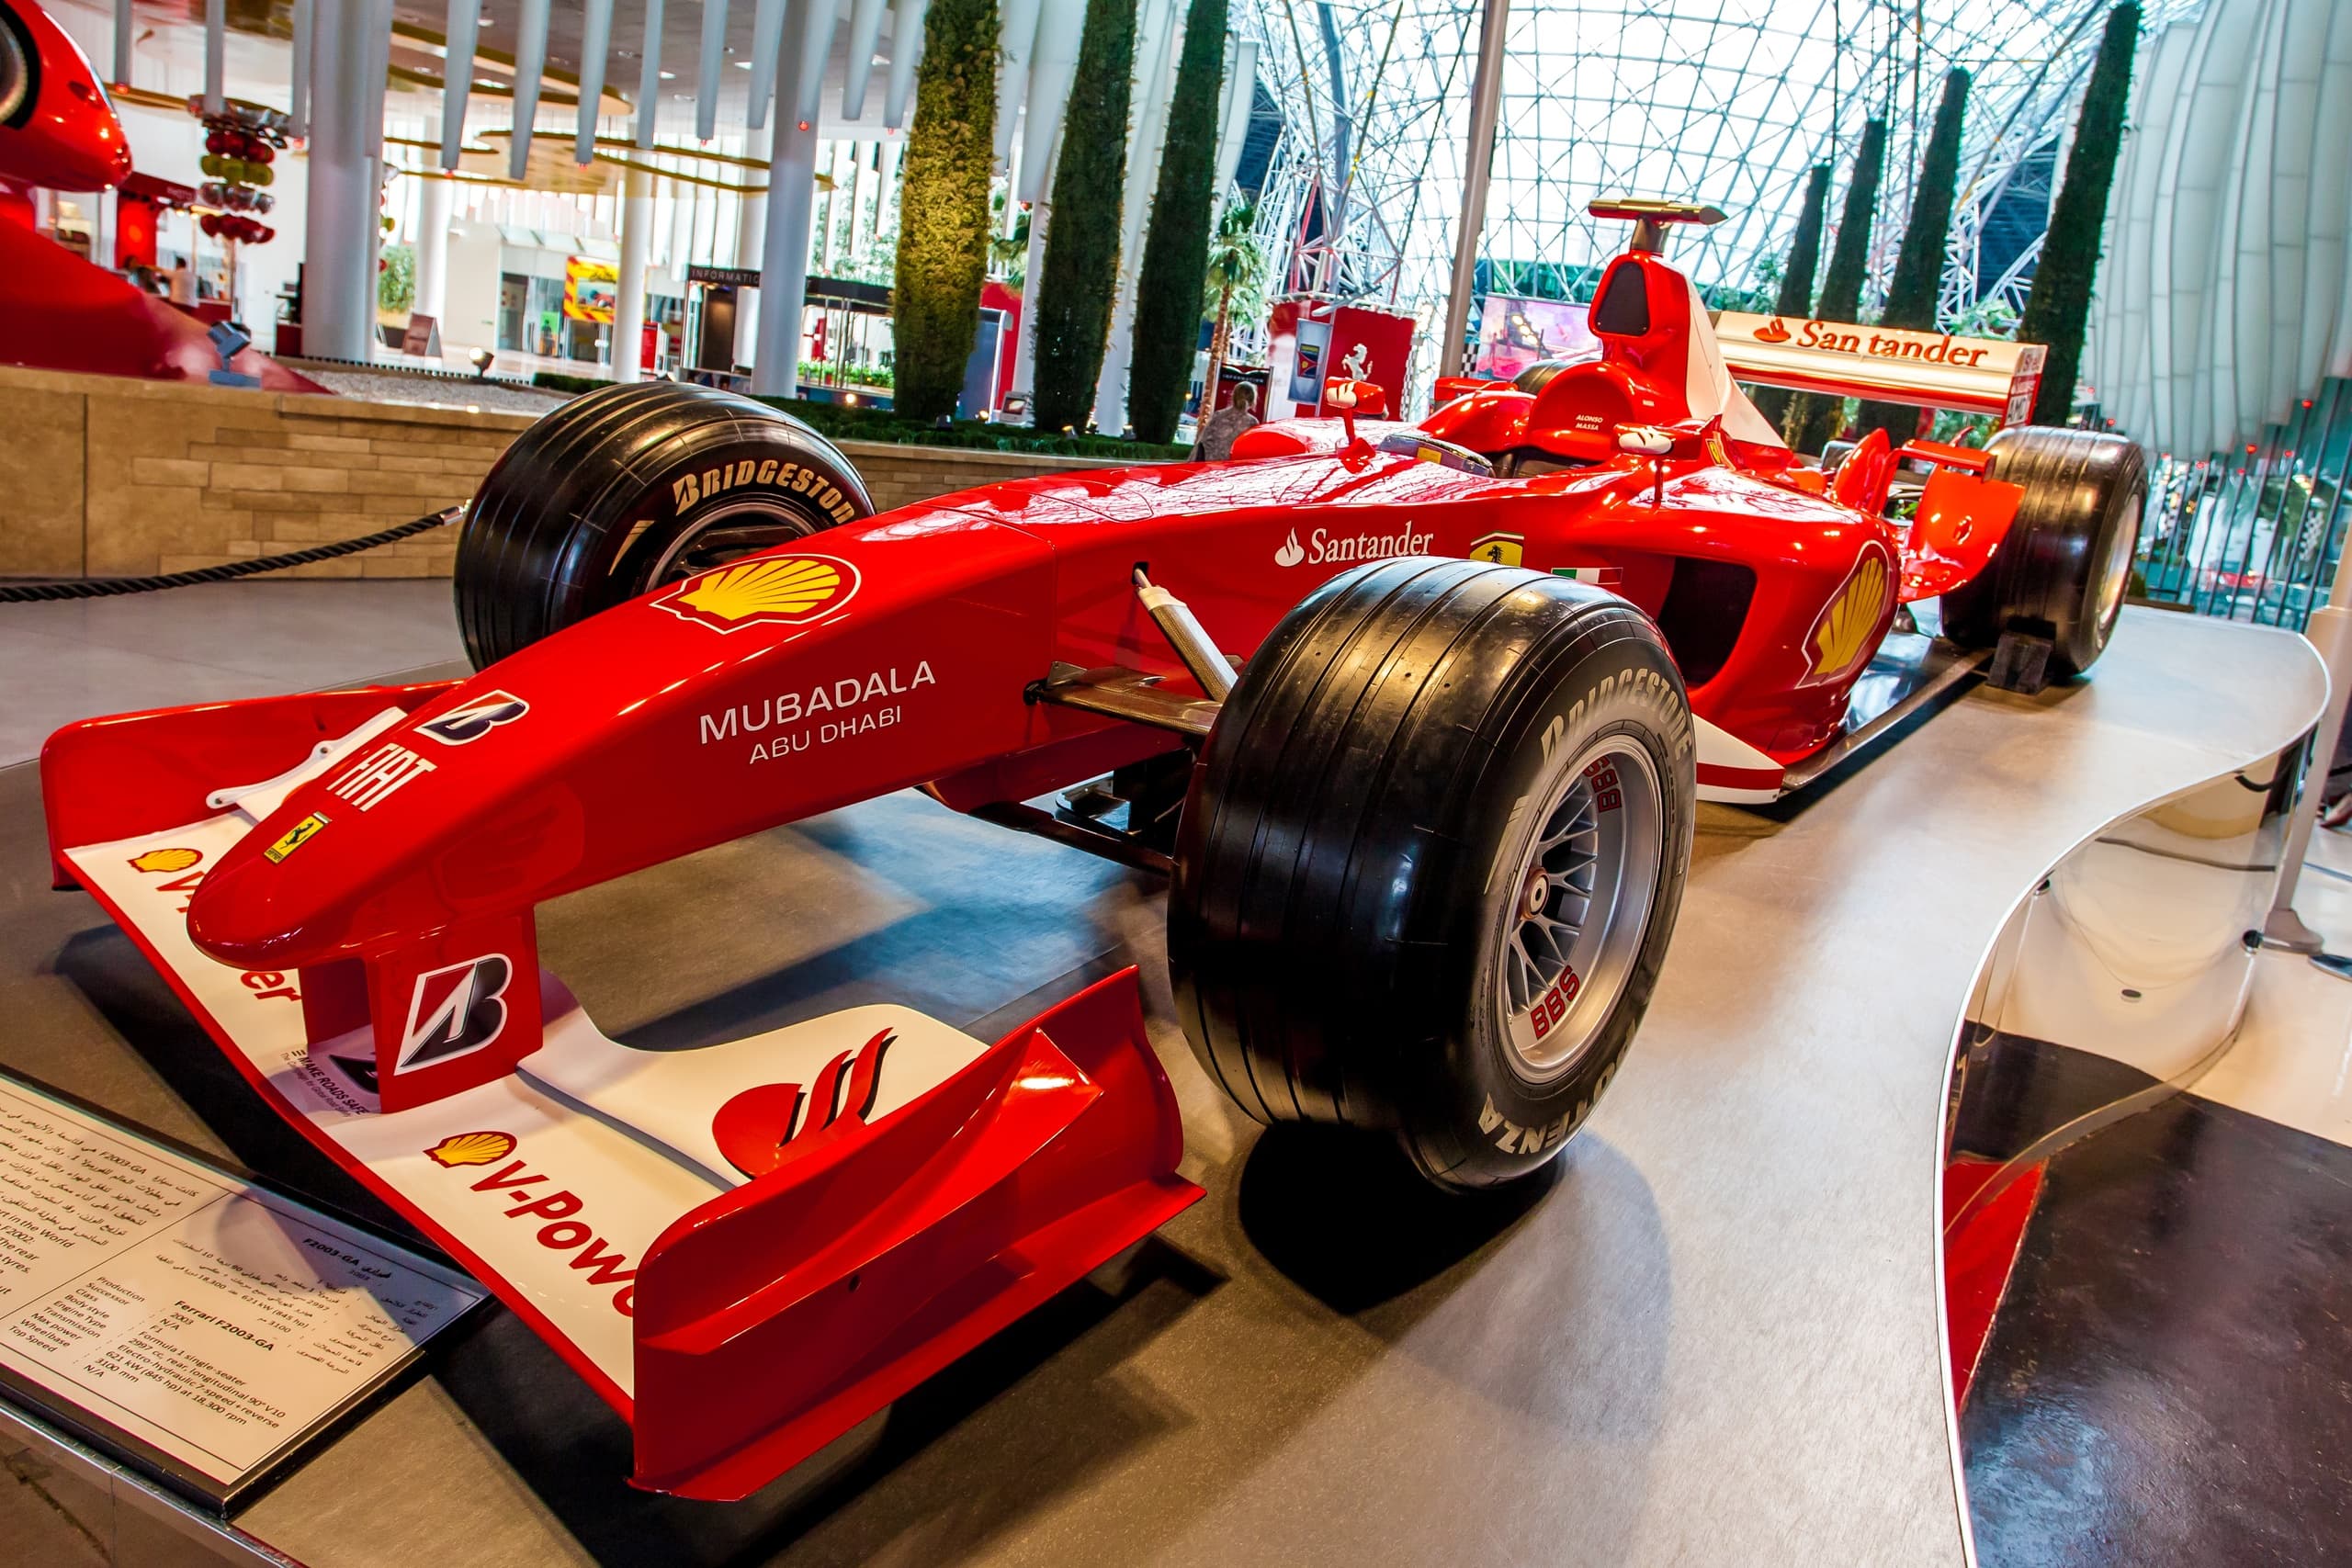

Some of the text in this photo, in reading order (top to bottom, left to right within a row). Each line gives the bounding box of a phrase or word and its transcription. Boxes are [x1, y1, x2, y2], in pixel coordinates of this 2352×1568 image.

[691, 269, 760, 285] INFORMATIO
[1575, 423, 1600, 431] MASSA
[1576, 414, 1603, 423] ALONSO
[673, 459, 855, 525] BRIDGESTON
[1307, 520, 1434, 565] Santander
[699, 660, 936, 745] MUBADALA
[749, 705, 901, 764] ABU DHABI
[326, 742, 438, 812] FIAT
[1530, 964, 1580, 1041] BBS
[298, 1056, 325, 1078] MAKE
[317, 1077, 349, 1100] ROADS
[342, 1099, 370, 1115] SAFE
[98, 1151, 147, 1175] F2003-GA
[14, 1247, 40, 1261] rear
[19, 1221, 39, 1231] the
[40, 1229, 75, 1248] World
[302, 1238, 361, 1267] F2003-GA
[469, 1159, 637, 1317] V-Pow
[75, 1288, 164, 1334] Class F1
[85, 1281, 180, 1331] Successor N/A
[96, 1276, 195, 1325] Production 2003
[175, 1300, 276, 1351] Ferrari F2003-GA
[270, 1319, 292, 1334] 3100
[9, 1325, 106, 1378] Top Speed N/A
[20, 1318, 140, 1383] Wheelbase 3100 mm
[53, 1300, 85, 1318] Engine
[85, 1314, 107, 1329] Type
[128, 1337, 154, 1353] 2997
[189, 1367, 251, 1401] longitudinal
[64, 1294, 90, 1309] Body
[86, 1303, 110, 1319] style
[139, 1331, 181, 1354] Formula
[185, 1352, 247, 1387] single-seater
[31, 1313, 51, 1325] Max
[50, 1322, 83, 1340] power
[106, 1350, 126, 1362] 621
[124, 1359, 144, 1371] kW
[141, 1366, 164, 1383] (845
[163, 1377, 182, 1393] hp)
[180, 1387, 193, 1398] at
[191, 1394, 226, 1415] 18,300
[225, 1412, 247, 1426] rpm
[43, 1306, 101, 1338] Transmission
[241, 1405, 280, 1429] reverse
